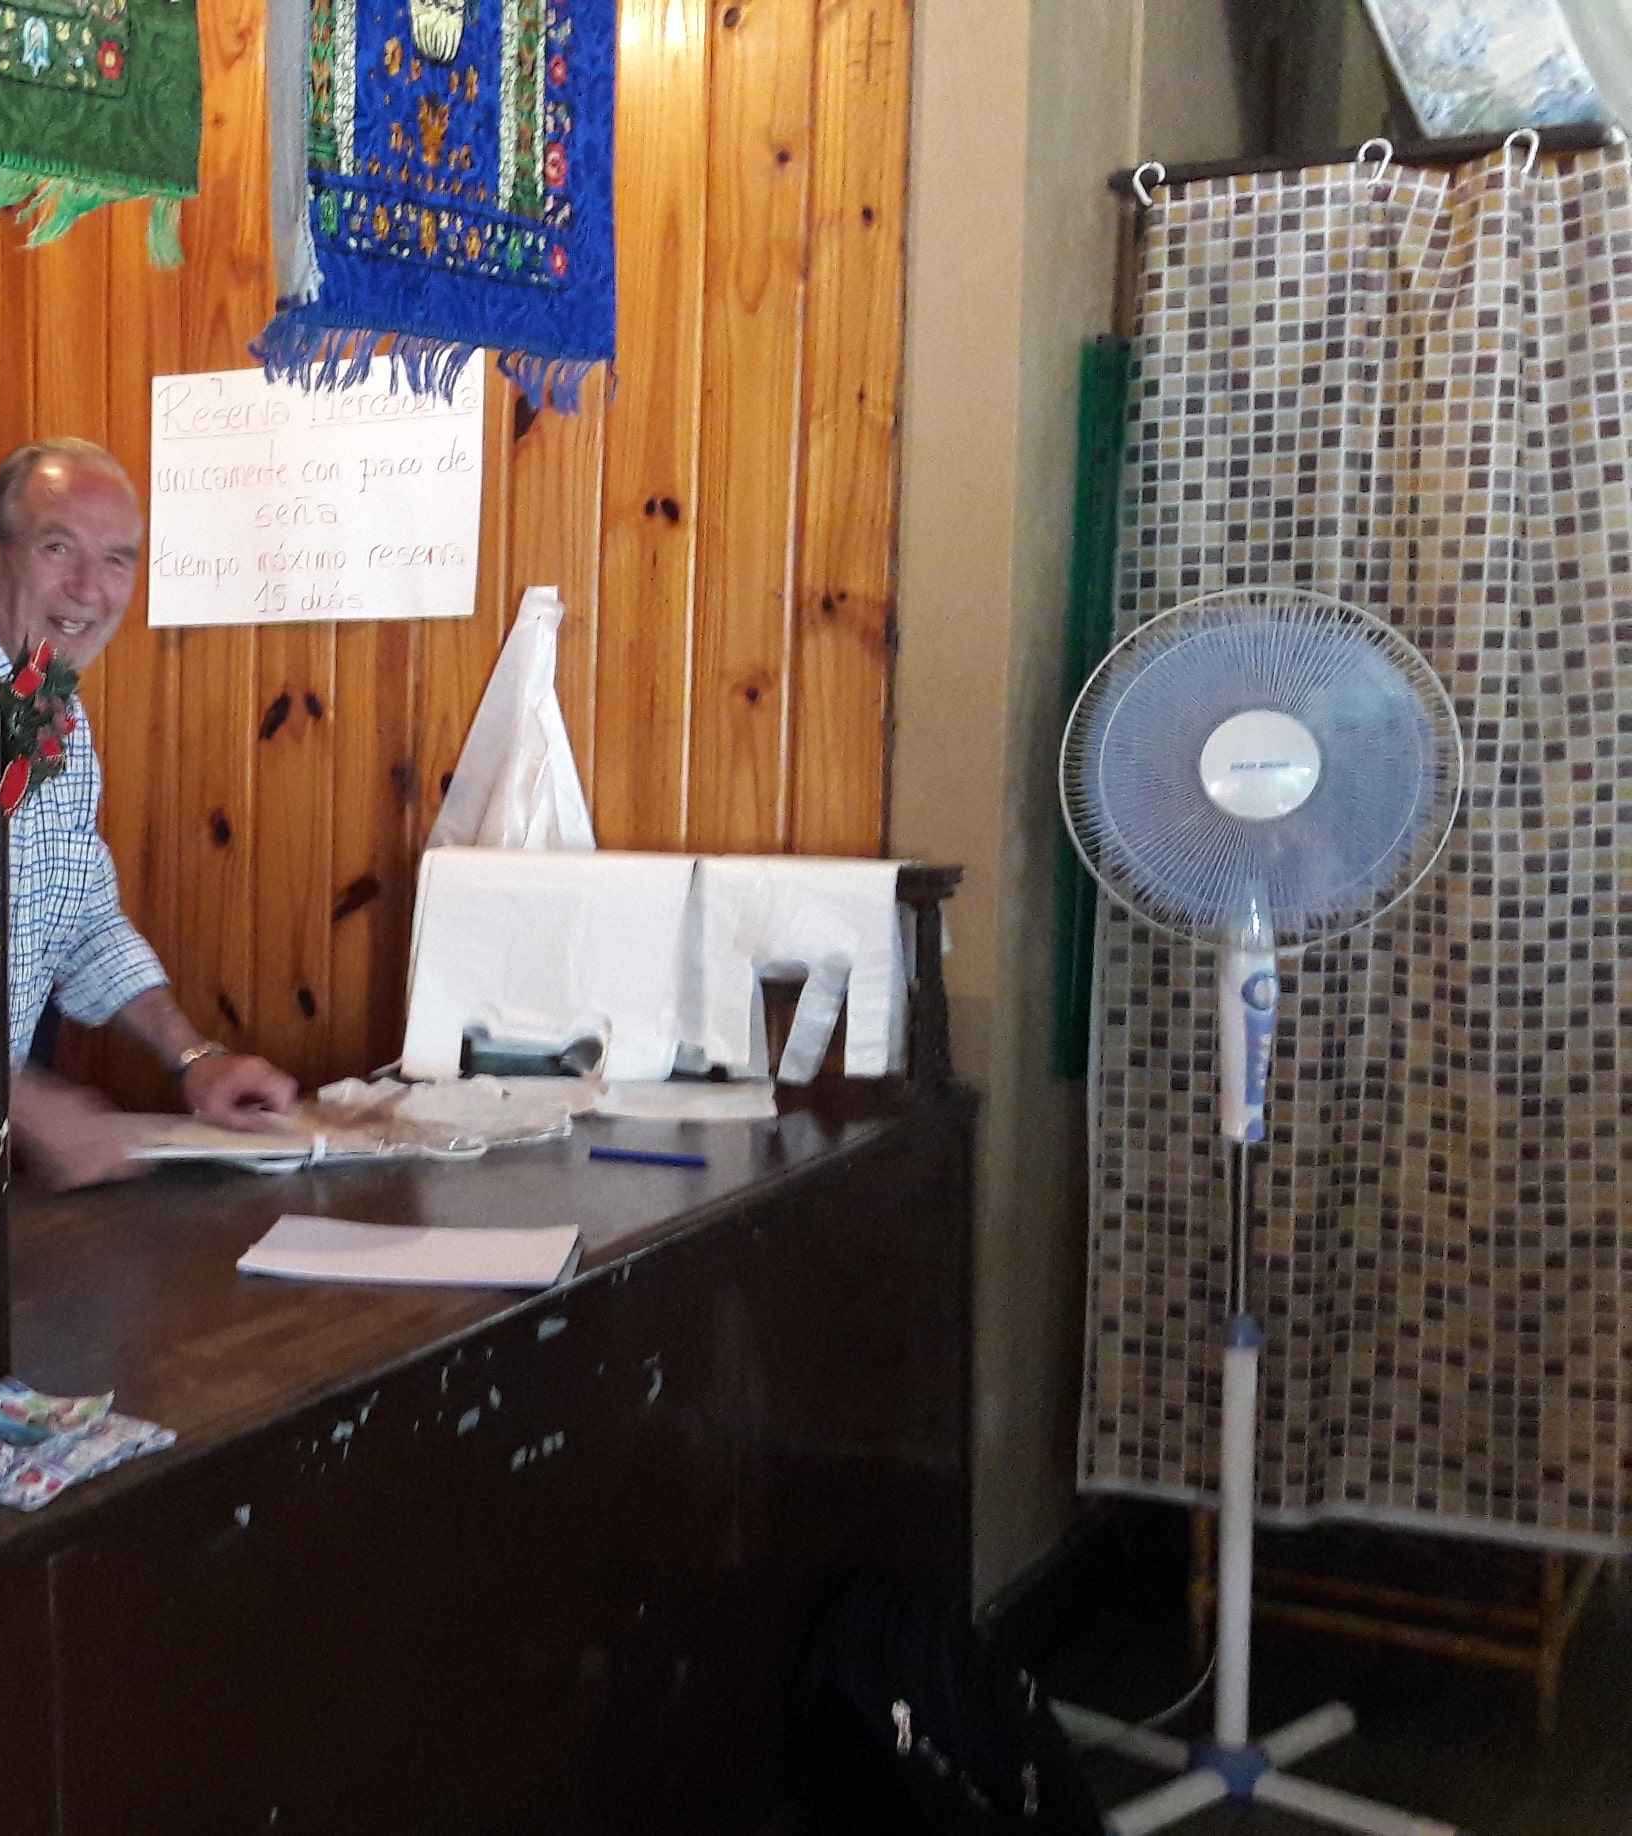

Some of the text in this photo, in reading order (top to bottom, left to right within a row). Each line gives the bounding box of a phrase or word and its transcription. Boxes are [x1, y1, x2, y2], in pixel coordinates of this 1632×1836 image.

[157, 381, 290, 433] Reserva
[302, 460, 340, 483] con
[437, 434, 475, 474] de
[254, 496, 338, 528] seña
[152, 537, 241, 587] tiempo
[253, 580, 289, 613] 15
